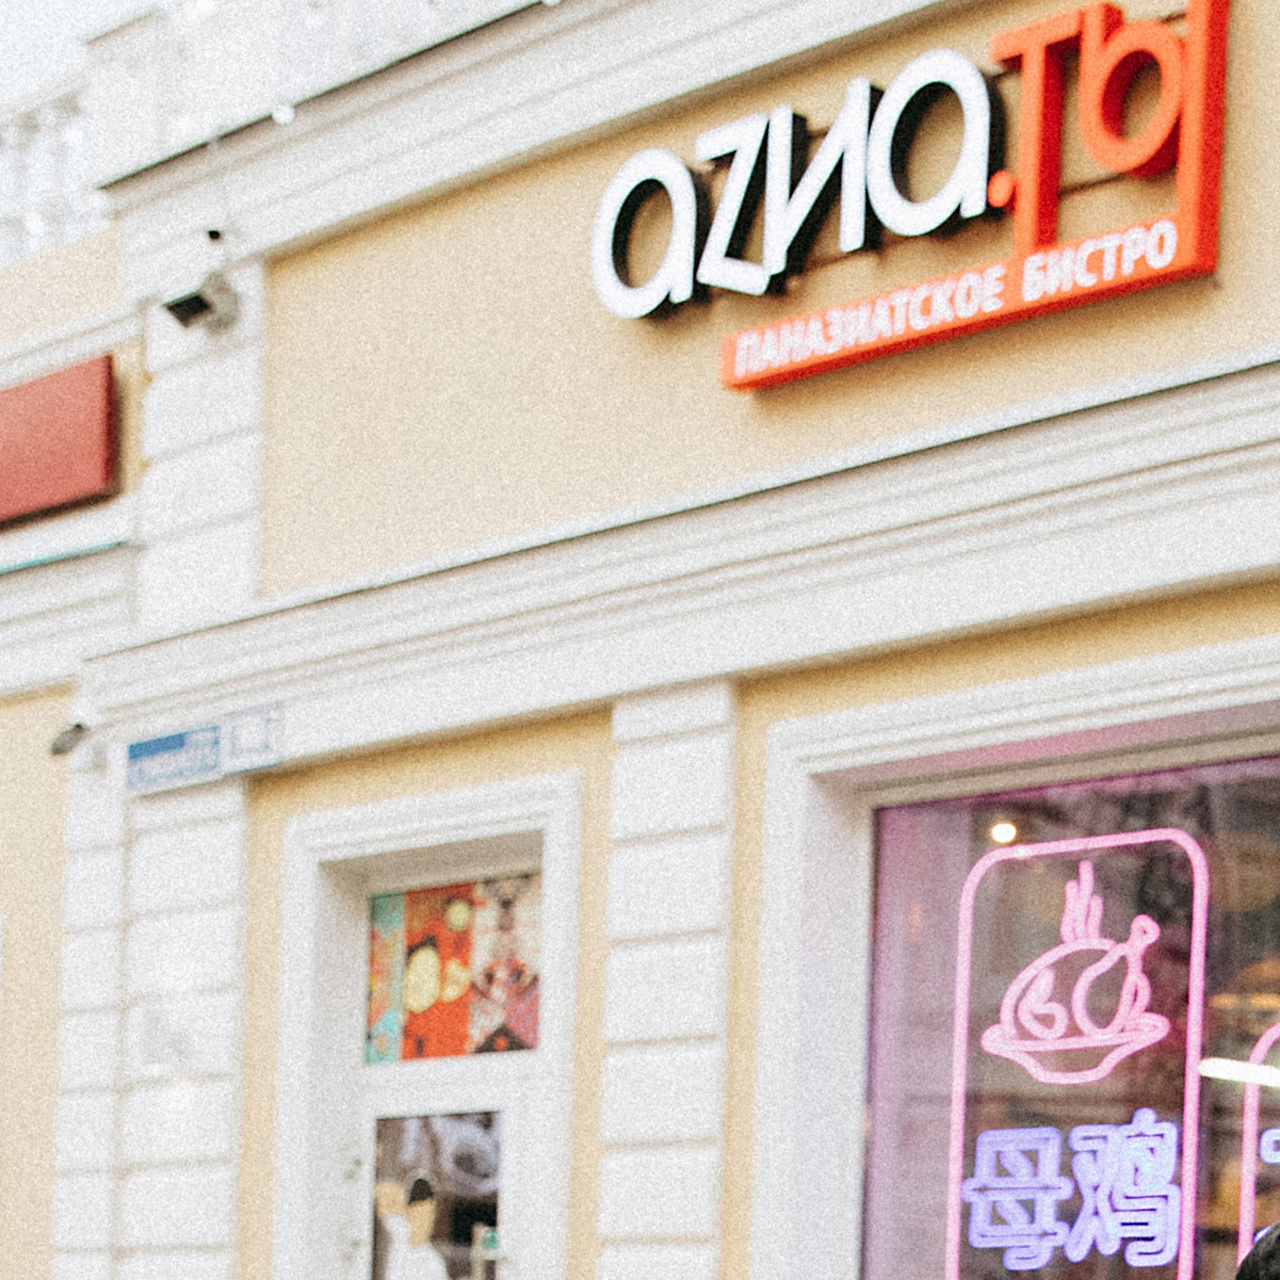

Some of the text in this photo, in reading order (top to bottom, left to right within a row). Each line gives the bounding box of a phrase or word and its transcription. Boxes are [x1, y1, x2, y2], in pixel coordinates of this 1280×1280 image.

[734, 219, 1179, 379] ПАНАЗИАТСКОЕ БИСТРО
[961, 1107, 1182, 1271] 母鸡
